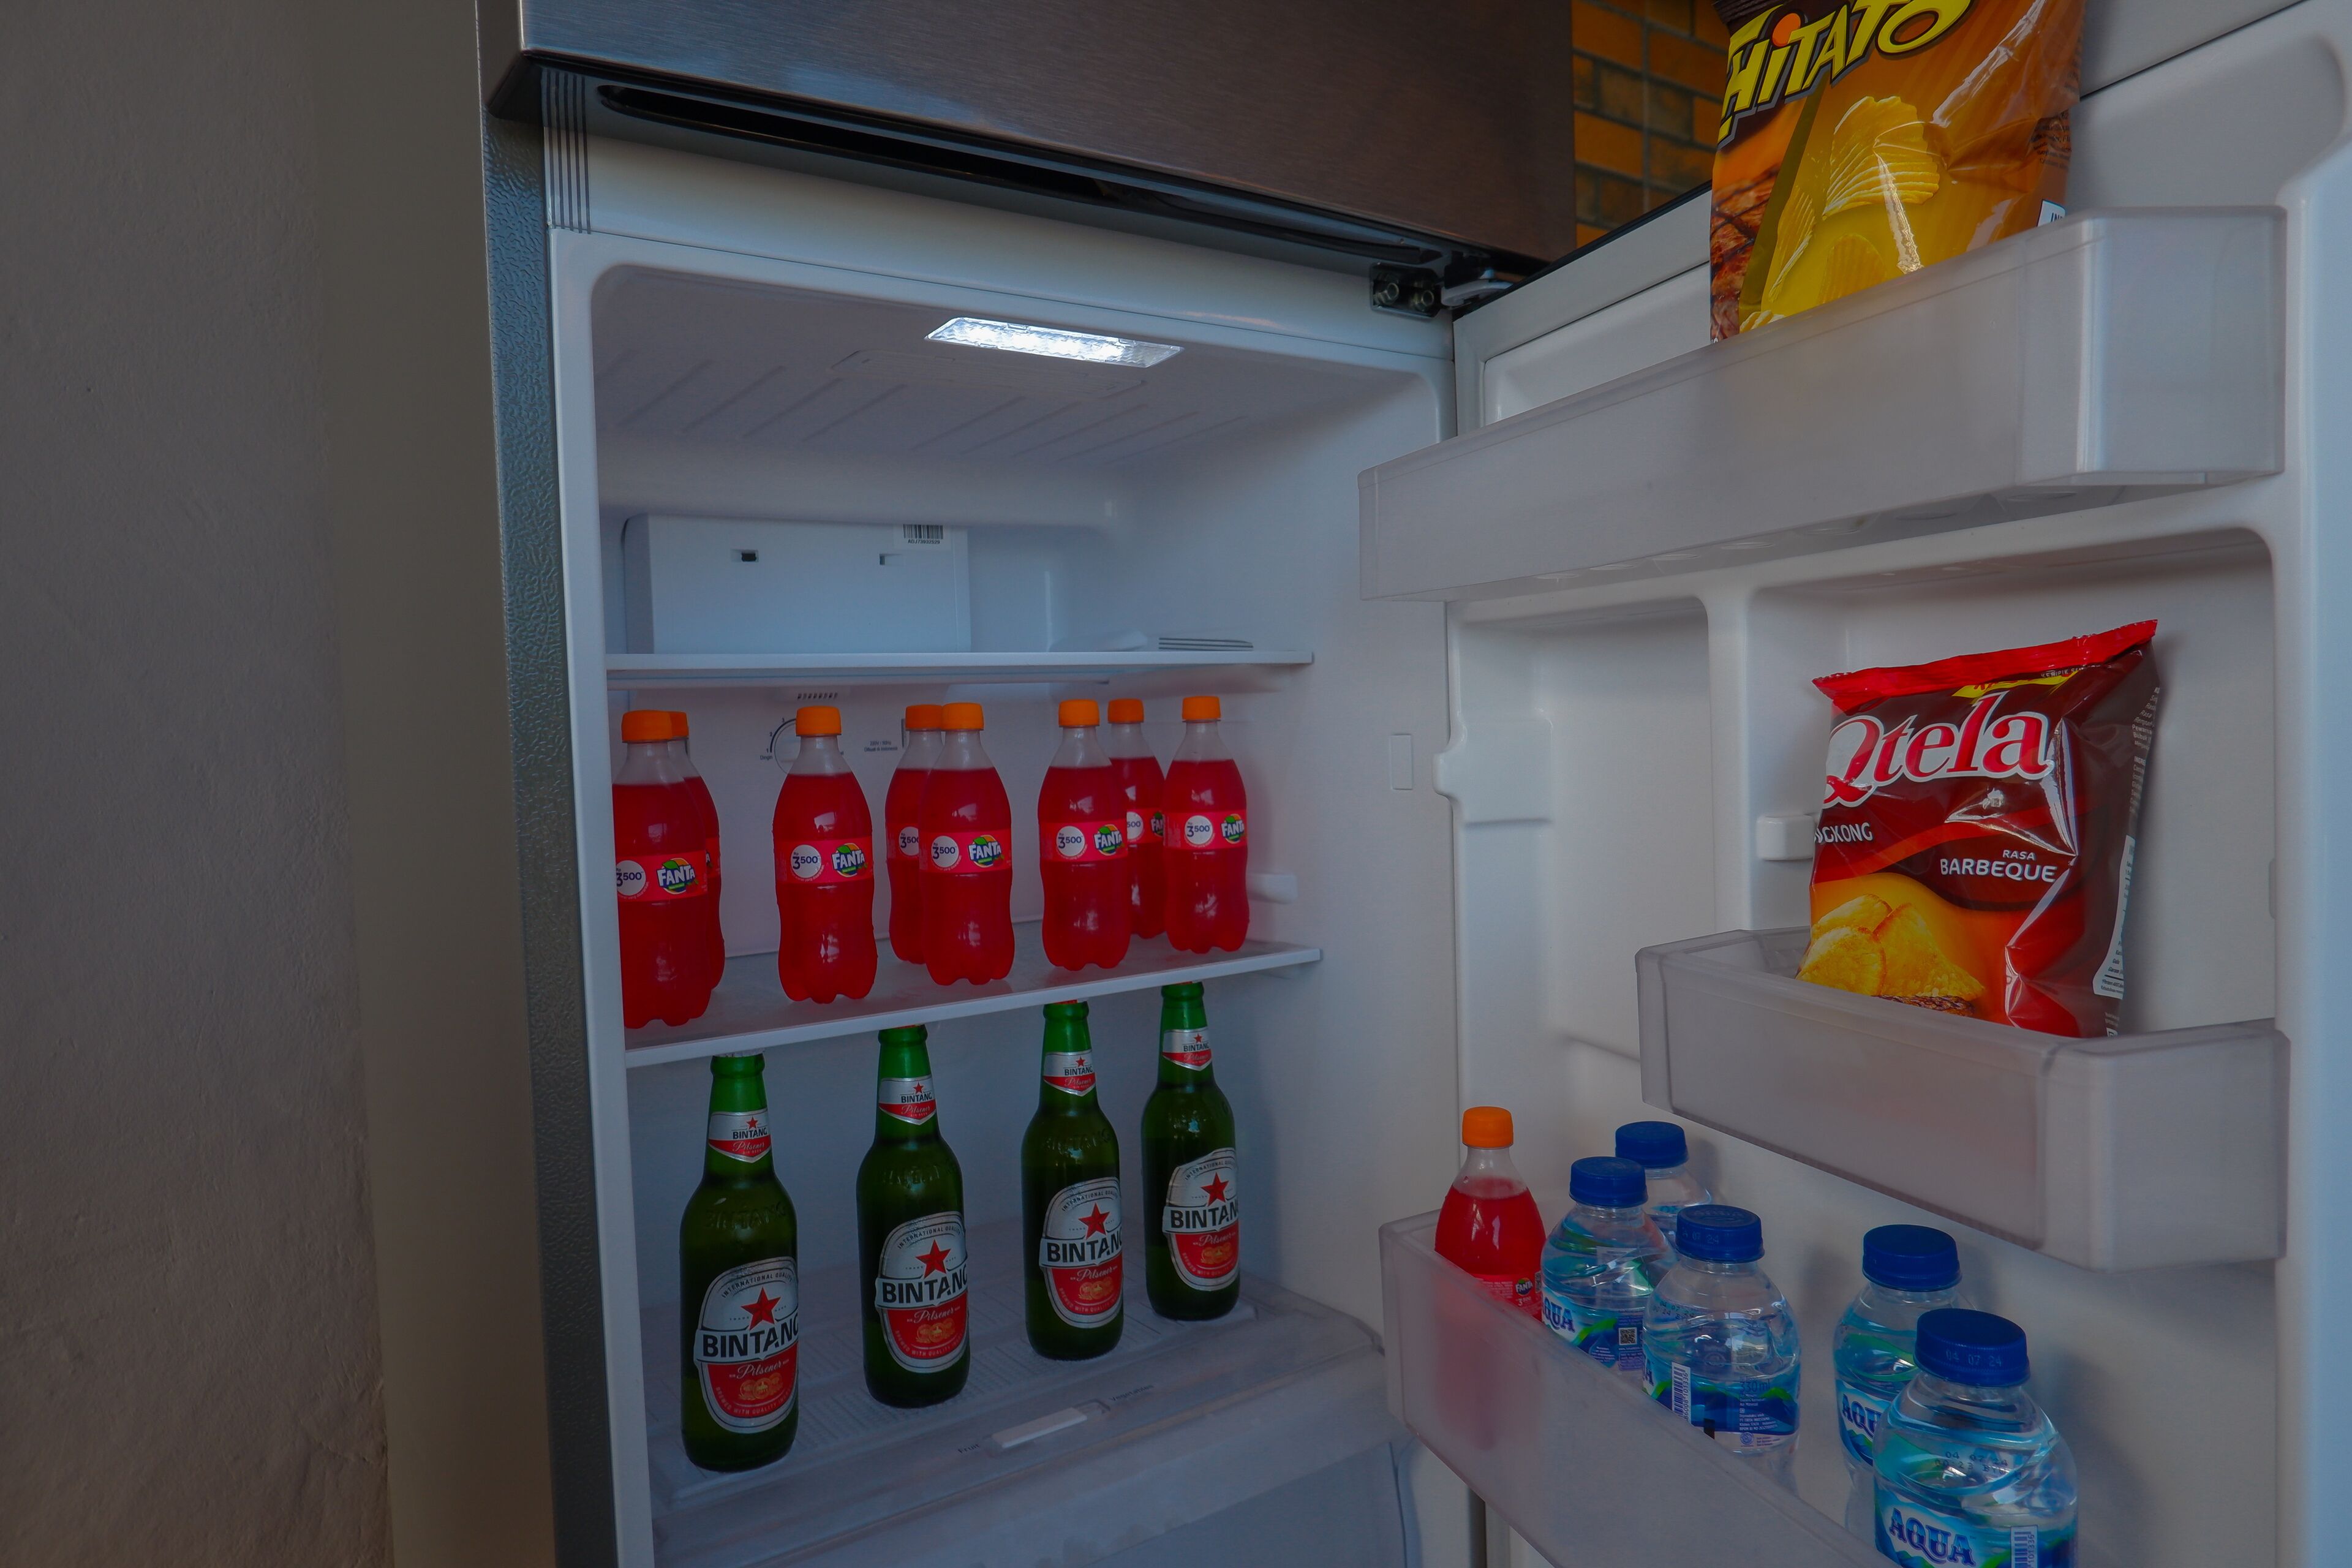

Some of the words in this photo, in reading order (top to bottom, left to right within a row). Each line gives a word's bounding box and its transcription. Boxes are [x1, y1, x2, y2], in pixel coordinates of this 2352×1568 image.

[1823, 690, 2056, 808] Qtela
[1094, 831, 1122, 849] FANTA
[1187, 825, 1210, 837] 3500
[968, 842, 1001, 860] FANTA
[1058, 836, 1082, 849] 3500
[832, 850, 865, 870] FANTA
[933, 847, 956, 859] 3500
[2002, 849, 2036, 861] RASA
[793, 856, 818, 870] 3500
[1940, 858, 2057, 883] BARBEQUE
[657, 864, 696, 887] FANTA
[901, 1092, 932, 1103] BINTANG
[733, 1127, 767, 1139] BINTANG
[733, 1140, 765, 1152] Pilsener
[897, 1227, 943, 1249] INTERNATIONAL
[1076, 1266, 1113, 1282] Pilsener
[722, 1273, 773, 1298] INTERNATIONAL
[913, 1306, 954, 1324] Pilsener
[736, 1360, 782, 1379] Pilsener
[1989, 1355, 2002, 1367] 24
[1889, 1507, 1977, 1566] AQUA
